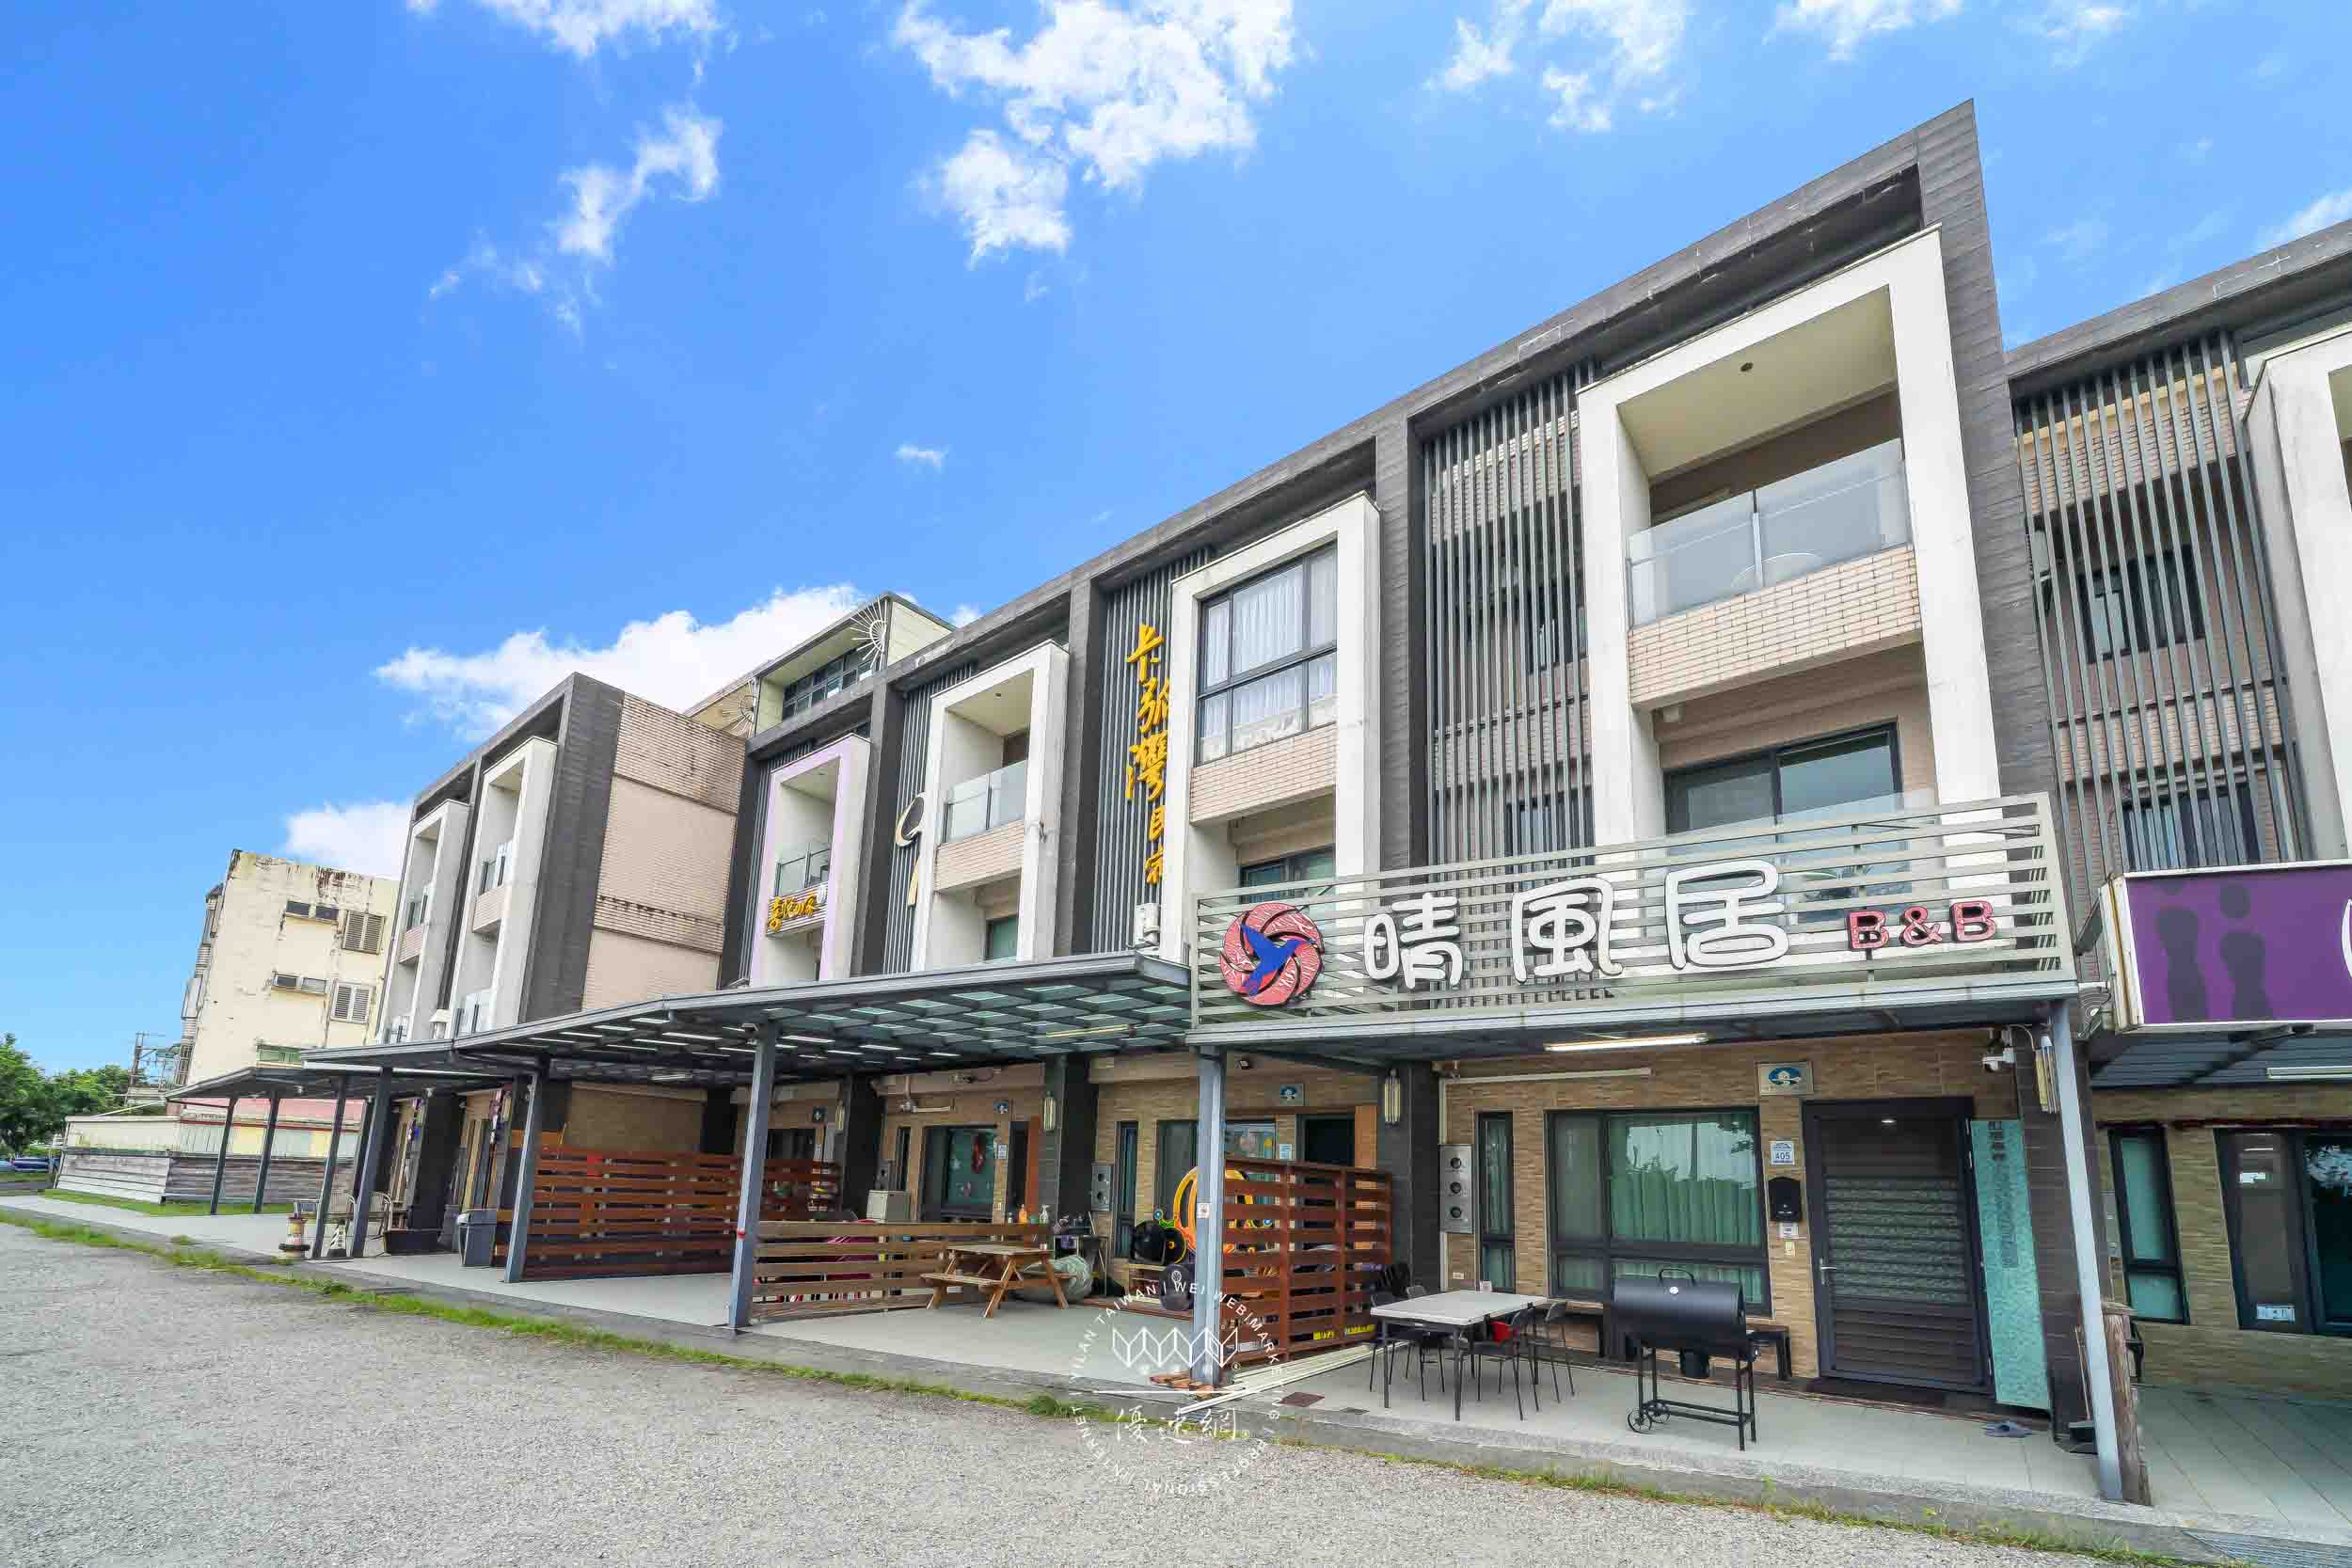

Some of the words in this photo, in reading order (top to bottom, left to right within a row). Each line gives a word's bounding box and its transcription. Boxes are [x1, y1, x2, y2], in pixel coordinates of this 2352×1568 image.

[1364, 859, 1789, 989] 晴風居
[1846, 900, 1997, 950] B&B
